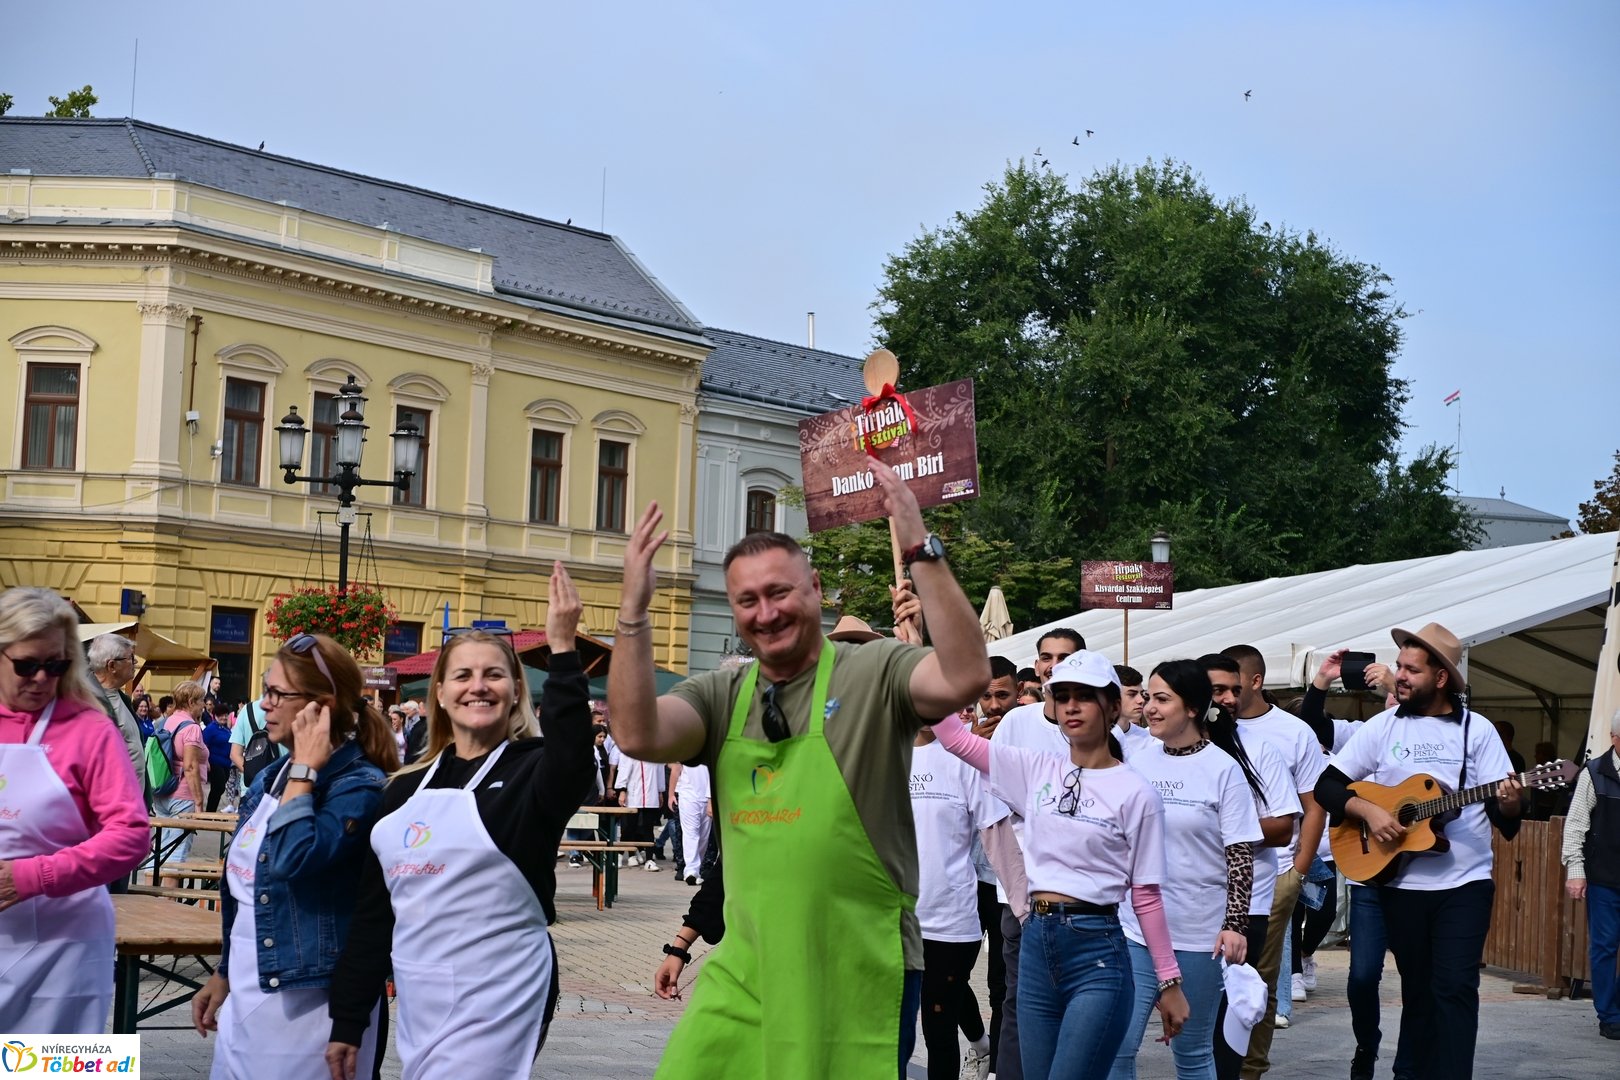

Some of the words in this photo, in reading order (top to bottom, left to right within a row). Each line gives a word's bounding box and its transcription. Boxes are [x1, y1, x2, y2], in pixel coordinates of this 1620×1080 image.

[854, 401, 905, 436] Tirpák
[859, 421, 907, 451] Fsztivál
[832, 467, 874, 497] Dankó
[916, 451, 945, 478] Biri
[1115, 563, 1140, 574] Tirpák
[1116, 595, 1142, 603] Centrum
